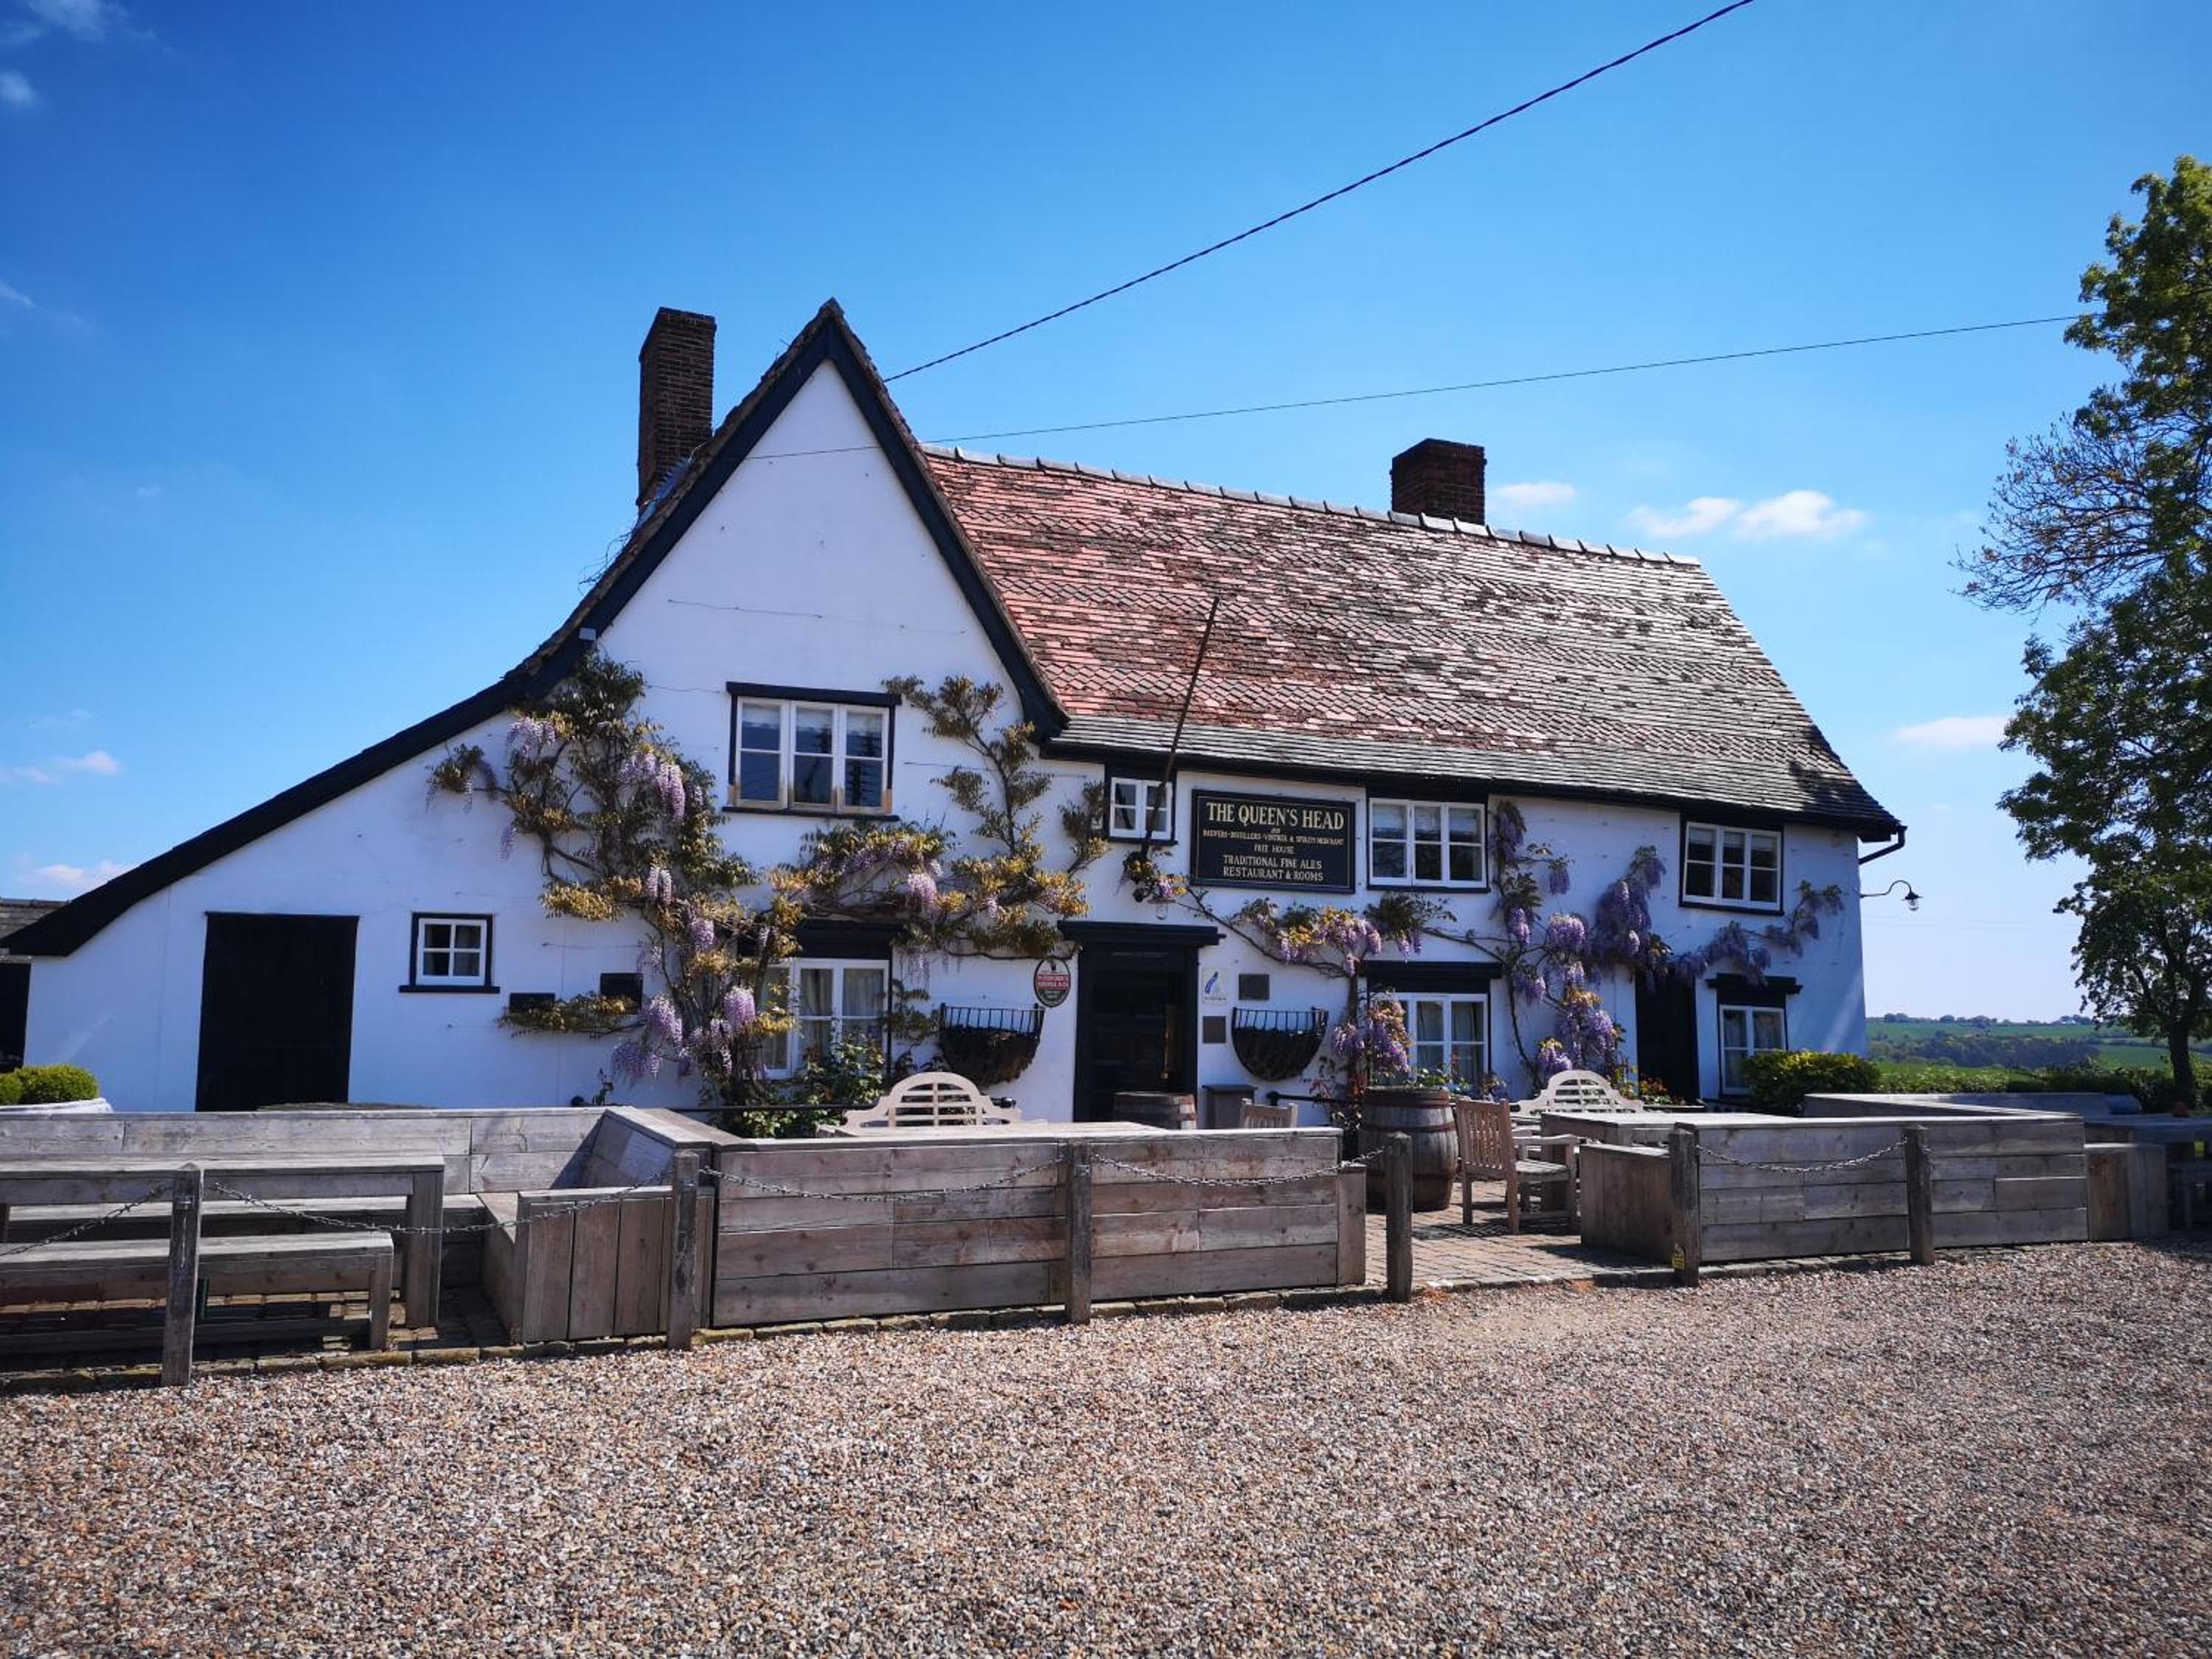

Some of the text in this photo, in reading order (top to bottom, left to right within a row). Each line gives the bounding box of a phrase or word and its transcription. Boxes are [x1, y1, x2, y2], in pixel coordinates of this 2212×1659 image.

[1206, 802, 1344, 830] THE QUEEN'S HEAD
[1254, 844, 1294, 854] FREE HOUSE
[1223, 855, 1322, 870] TRADITIONAL FINE ALES
[1223, 866, 1324, 882] RESTAURANT & ROOMS
